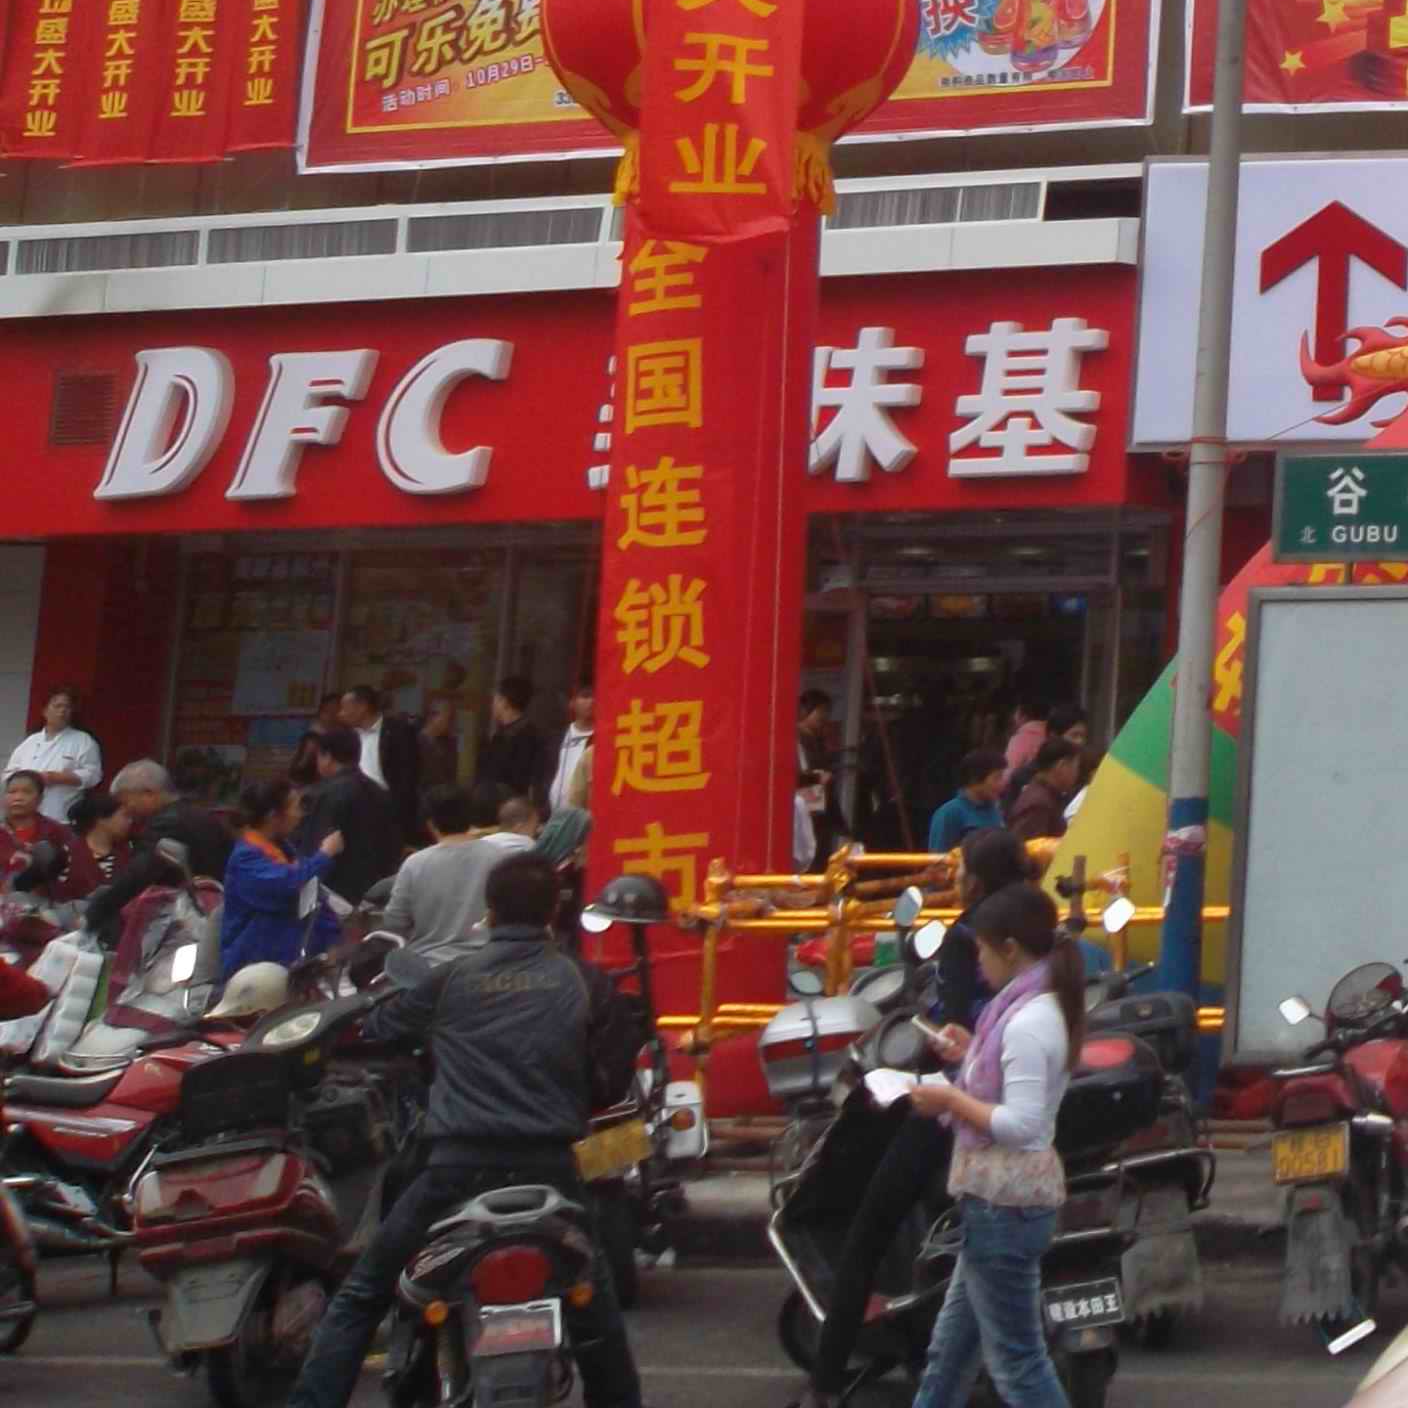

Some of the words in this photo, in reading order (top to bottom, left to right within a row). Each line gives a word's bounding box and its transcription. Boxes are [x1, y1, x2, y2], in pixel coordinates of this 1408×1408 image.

[92, 335, 515, 504] DFC
[609, 239, 712, 914] 全国连锁超市
[1299, 526, 1316, 544] 北
[1331, 524, 1399, 544] GUBU
